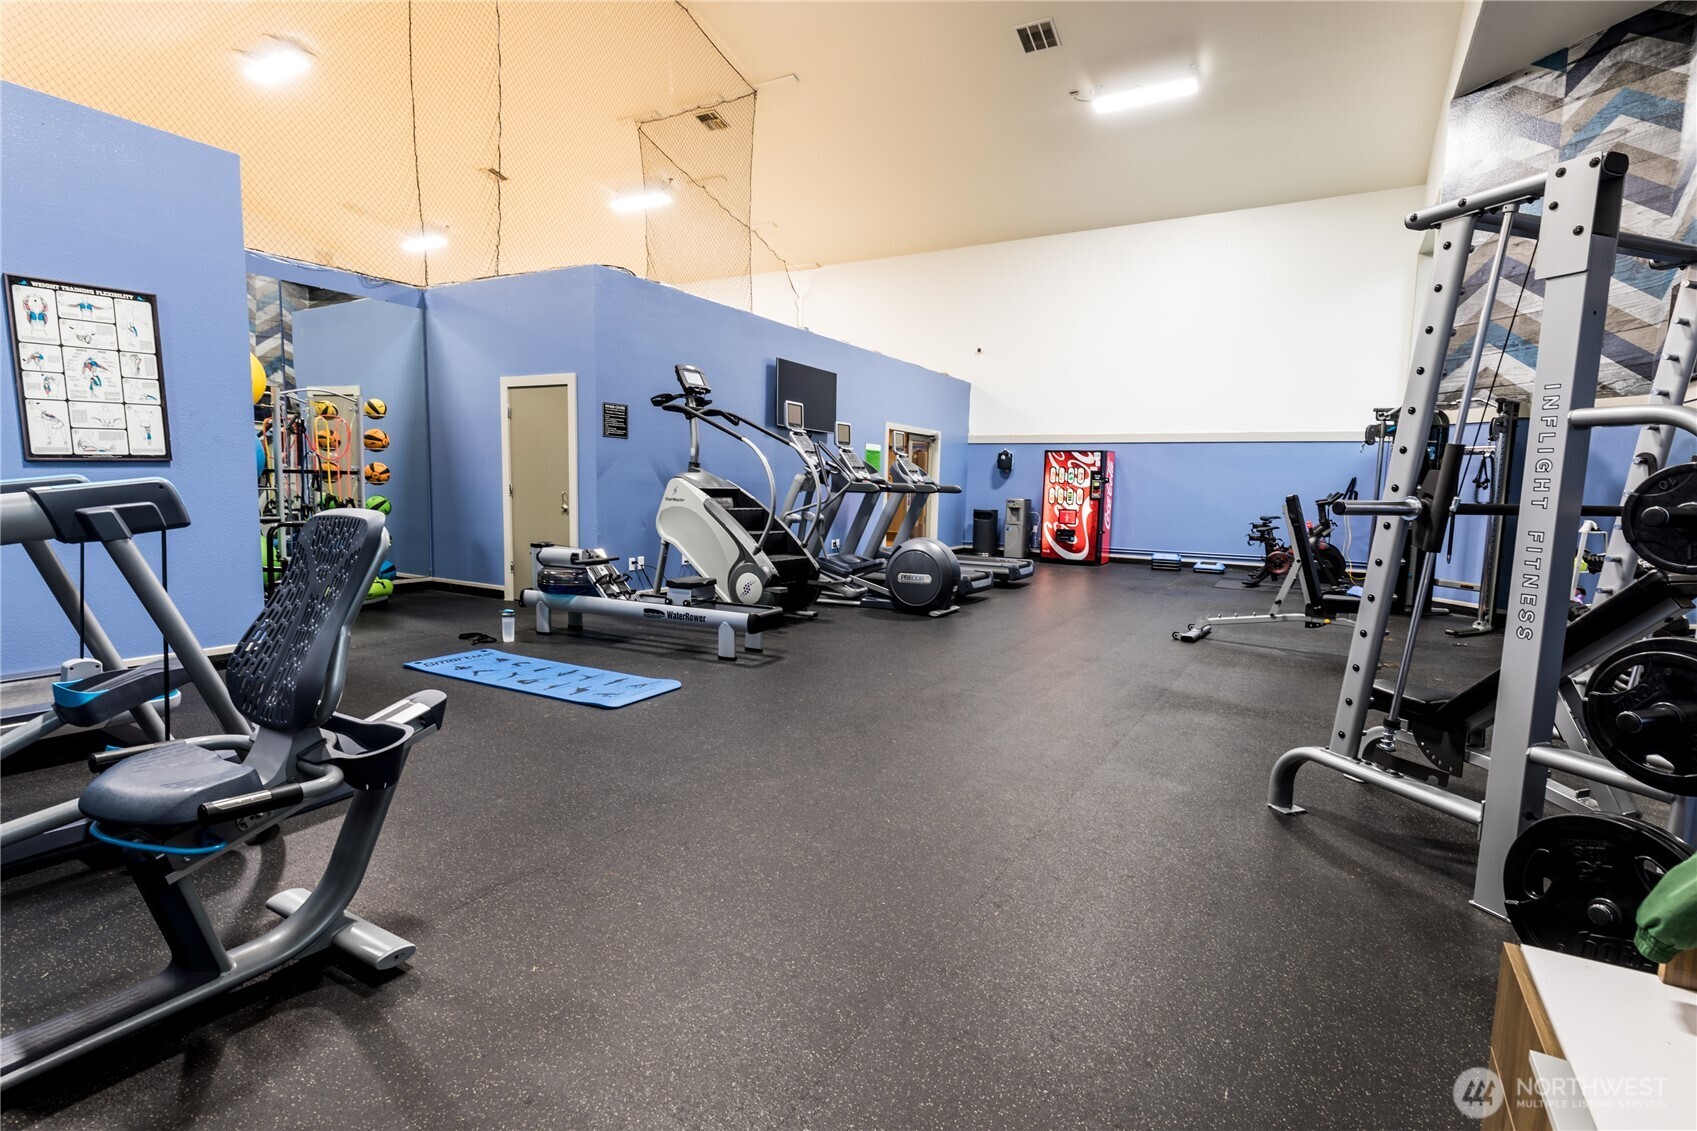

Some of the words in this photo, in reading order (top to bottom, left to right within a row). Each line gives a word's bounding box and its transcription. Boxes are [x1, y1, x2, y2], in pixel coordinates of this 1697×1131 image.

[30, 281, 59, 291] WEIGHT
[61, 285, 94, 295] TRAINING
[95, 290, 134, 300] FLEXIBILITY
[1530, 383, 1562, 510] INFLIGHT
[666, 610, 707, 623] WaterRower
[1516, 530, 1545, 641] FITNESS
